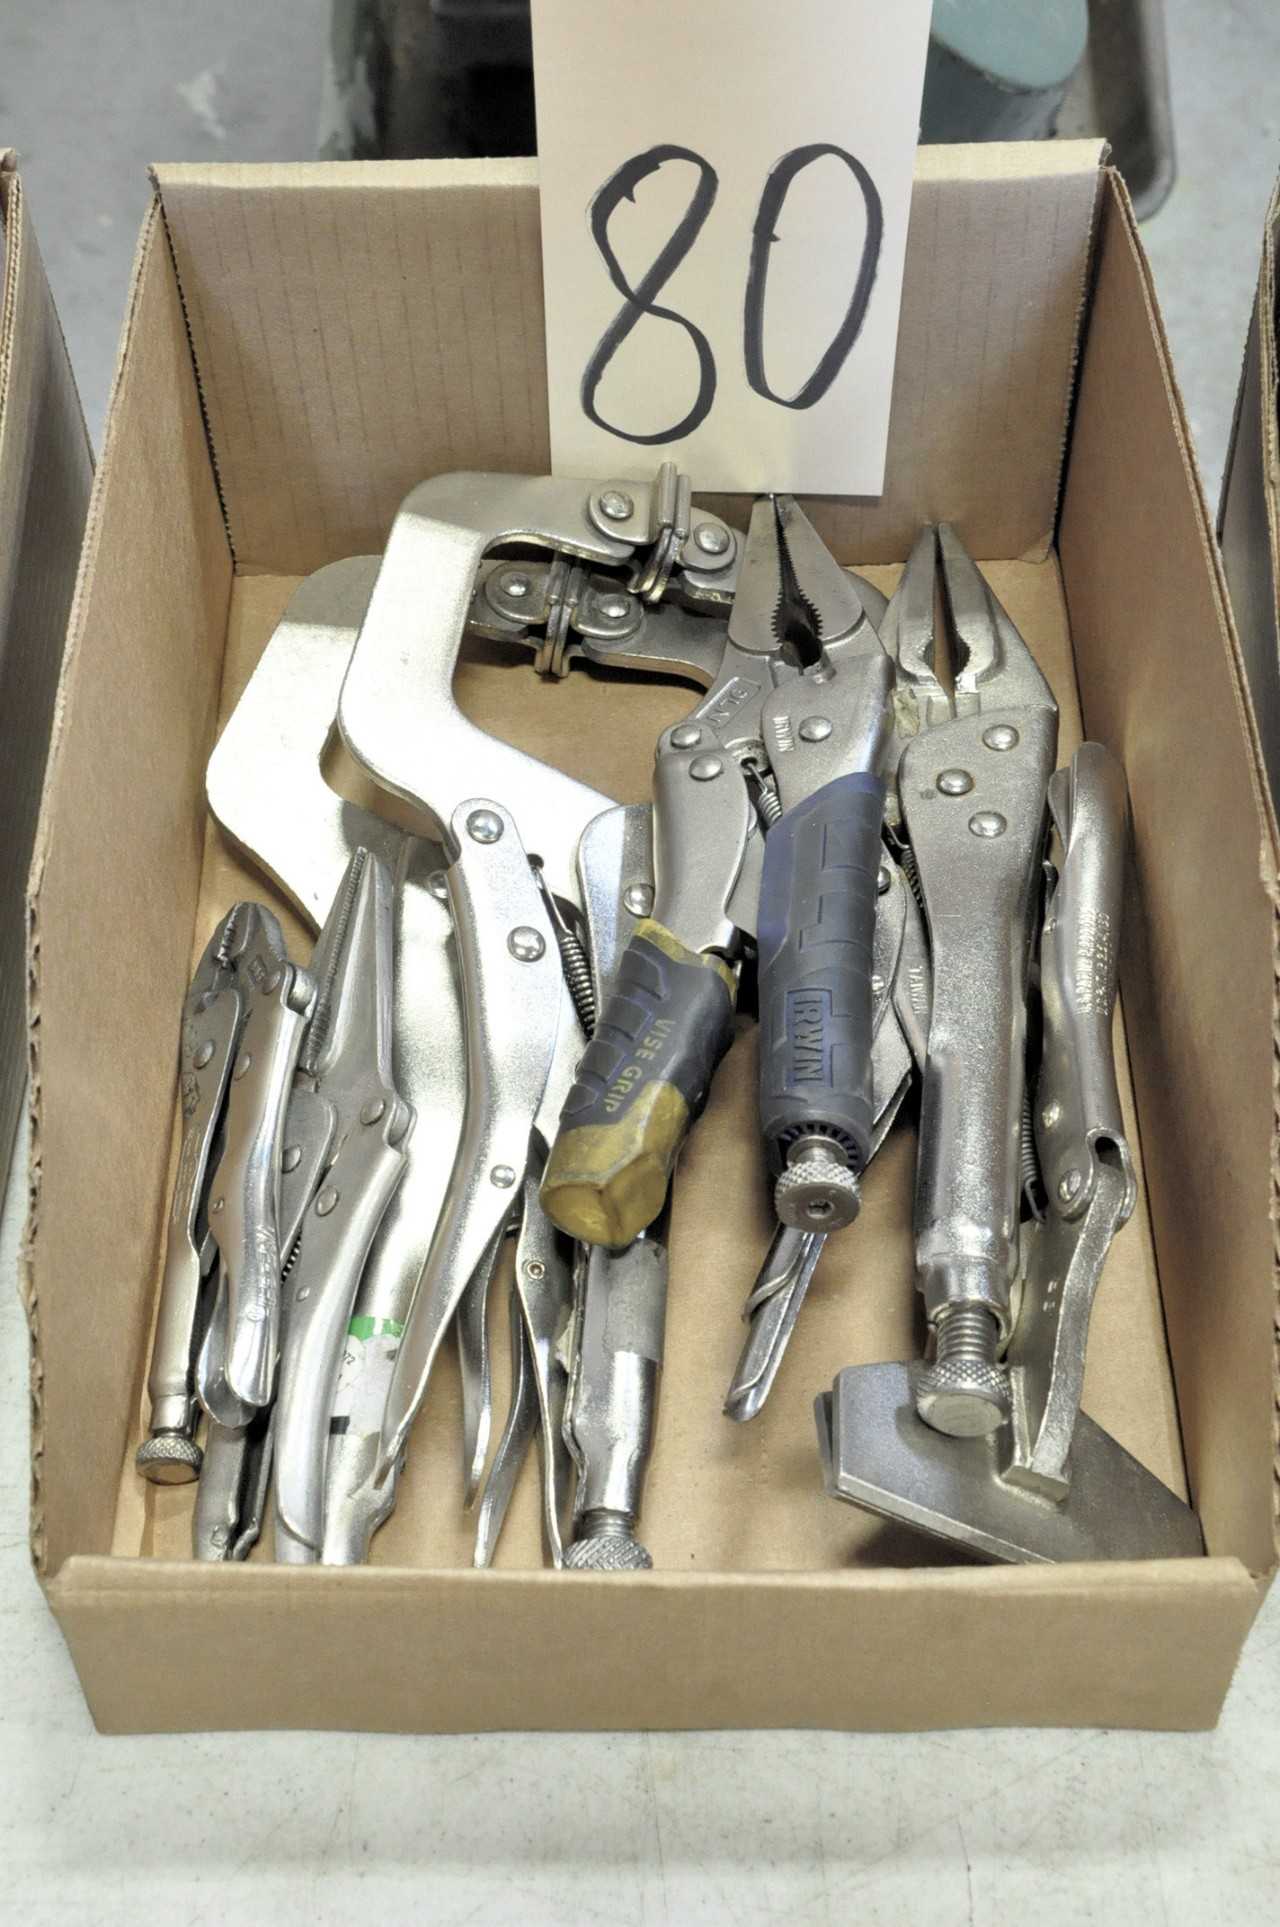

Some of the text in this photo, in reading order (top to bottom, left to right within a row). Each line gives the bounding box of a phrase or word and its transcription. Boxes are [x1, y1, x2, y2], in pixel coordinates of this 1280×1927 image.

[579, 143, 884, 445] 80
[604, 1018, 677, 1114] VISE GRIP
[793, 998, 824, 1084] IRWIN
